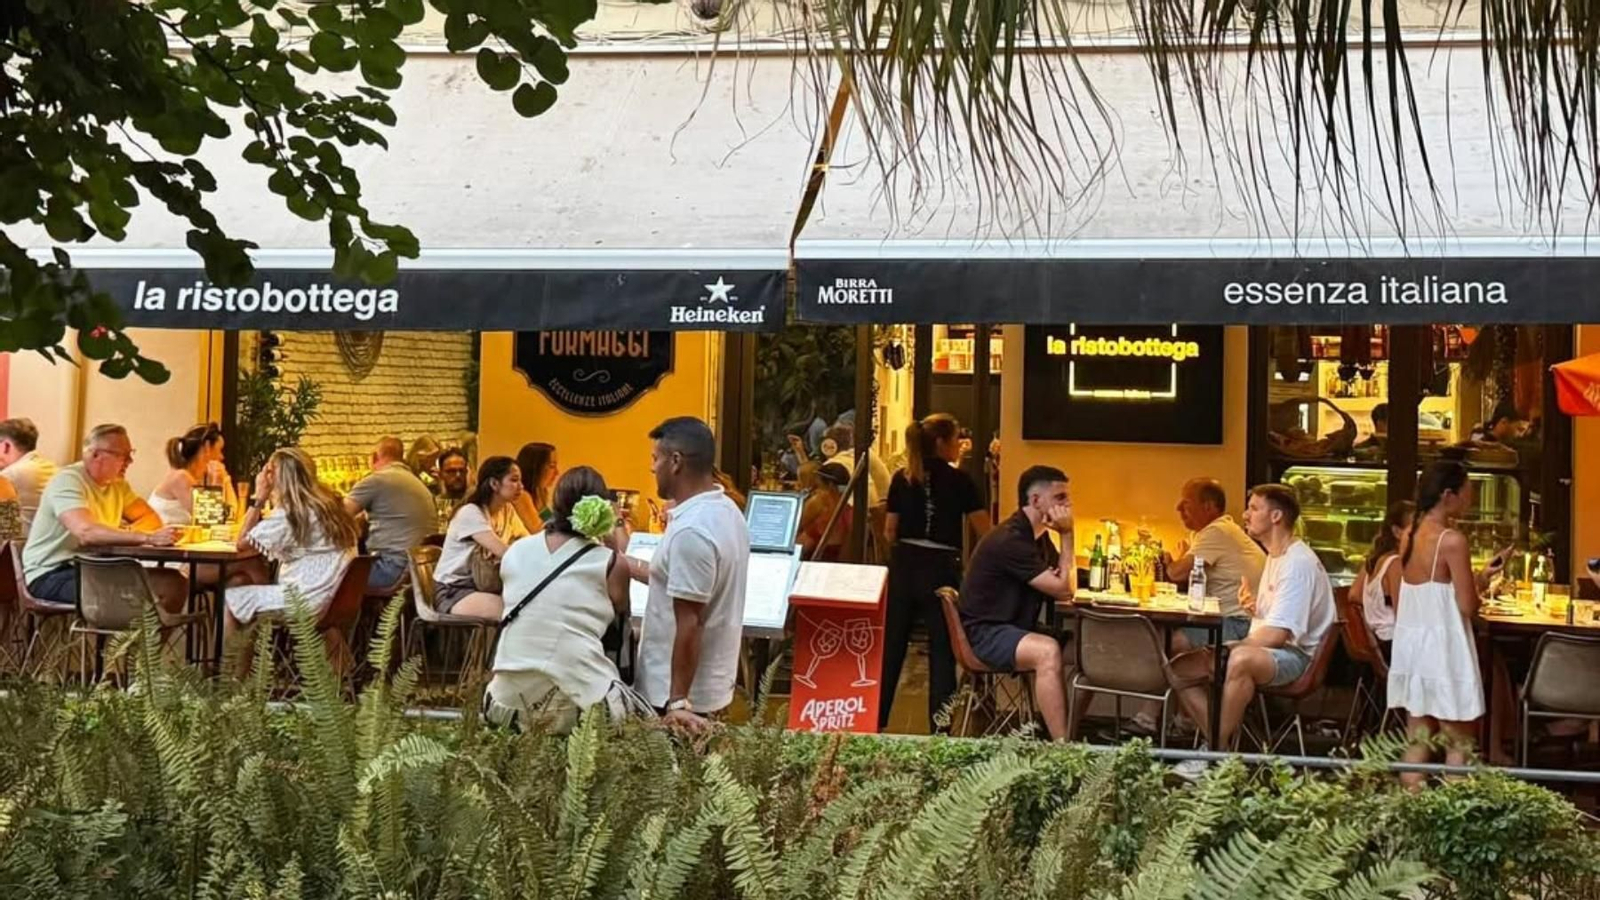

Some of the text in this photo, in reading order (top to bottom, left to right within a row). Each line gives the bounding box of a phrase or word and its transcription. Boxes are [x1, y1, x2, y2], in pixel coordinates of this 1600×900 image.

[818, 286, 893, 304] MORETTI
[835, 278, 878, 289] BIRRA
[1223, 275, 1508, 304] essenza italiana
[134, 281, 399, 321] la ristobottega
[670, 305, 765, 323] Heineken
[1047, 335, 1200, 362] la ristobottega
[800, 696, 867, 722] APEROL
[810, 713, 855, 733] SPRITZ
